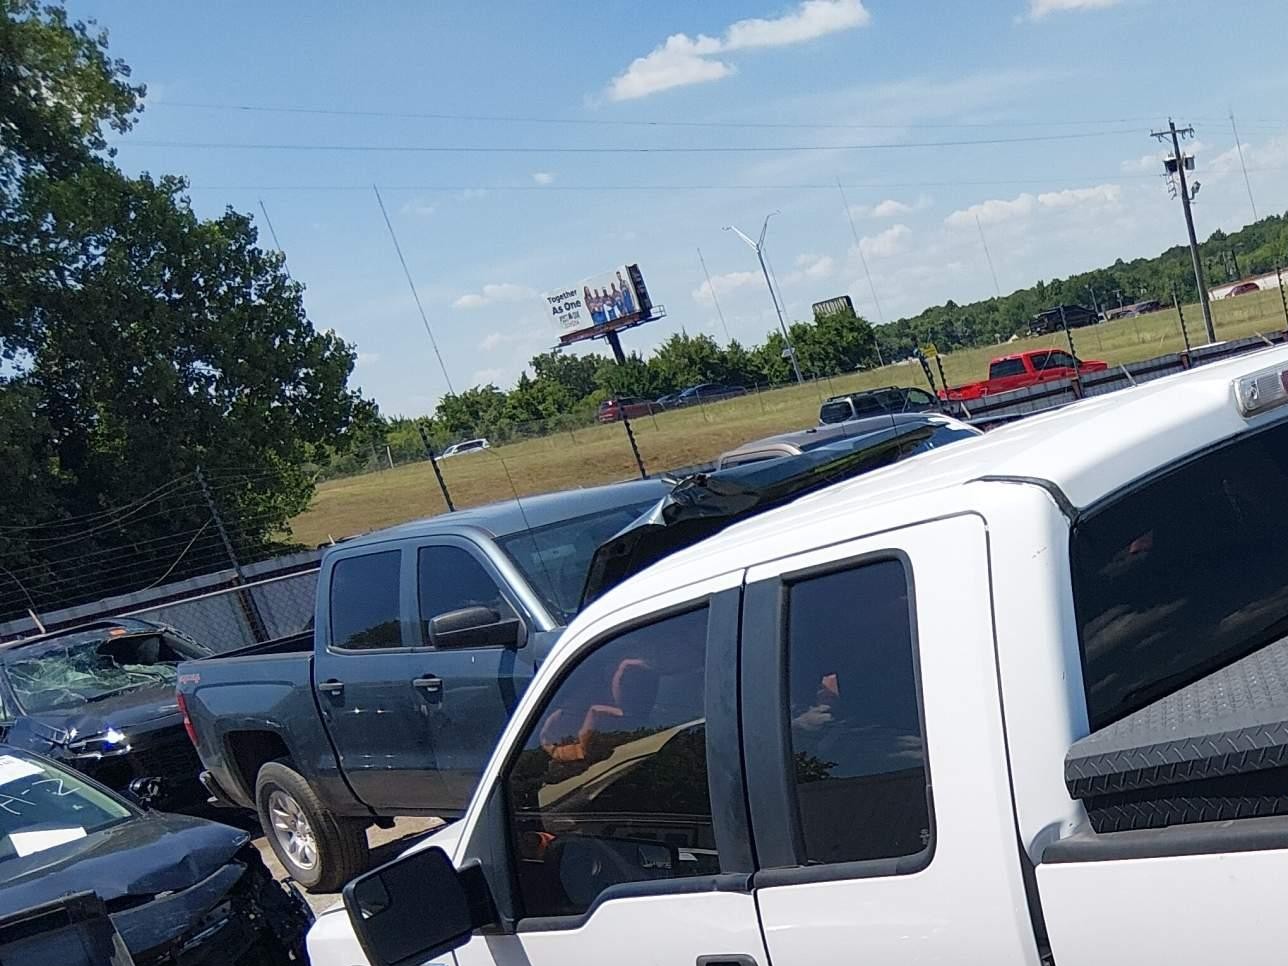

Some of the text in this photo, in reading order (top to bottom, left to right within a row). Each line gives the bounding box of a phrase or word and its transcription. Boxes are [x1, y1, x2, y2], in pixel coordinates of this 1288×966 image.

[547, 290, 576, 304] Together
[552, 300, 581, 315] As One
